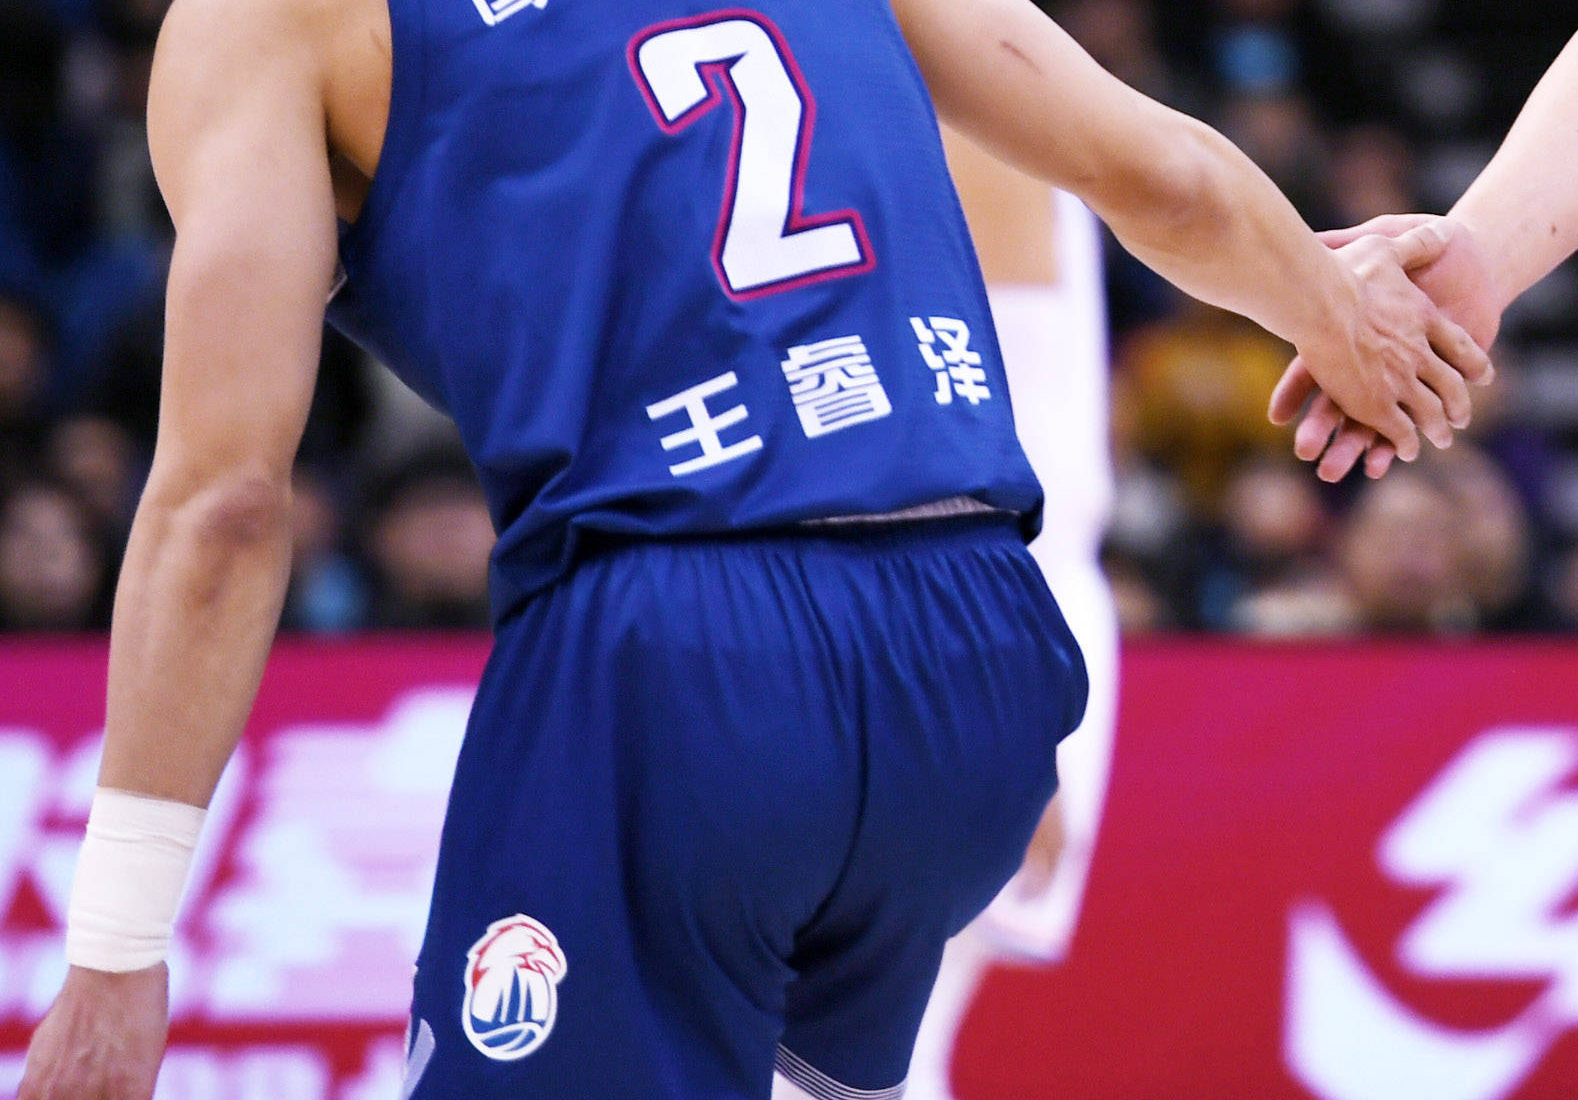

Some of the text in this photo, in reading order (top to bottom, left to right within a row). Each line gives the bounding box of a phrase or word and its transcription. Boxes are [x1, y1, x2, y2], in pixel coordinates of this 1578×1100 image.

[626, 7, 876, 302] 2
[646, 316, 992, 476] 王睿泽
